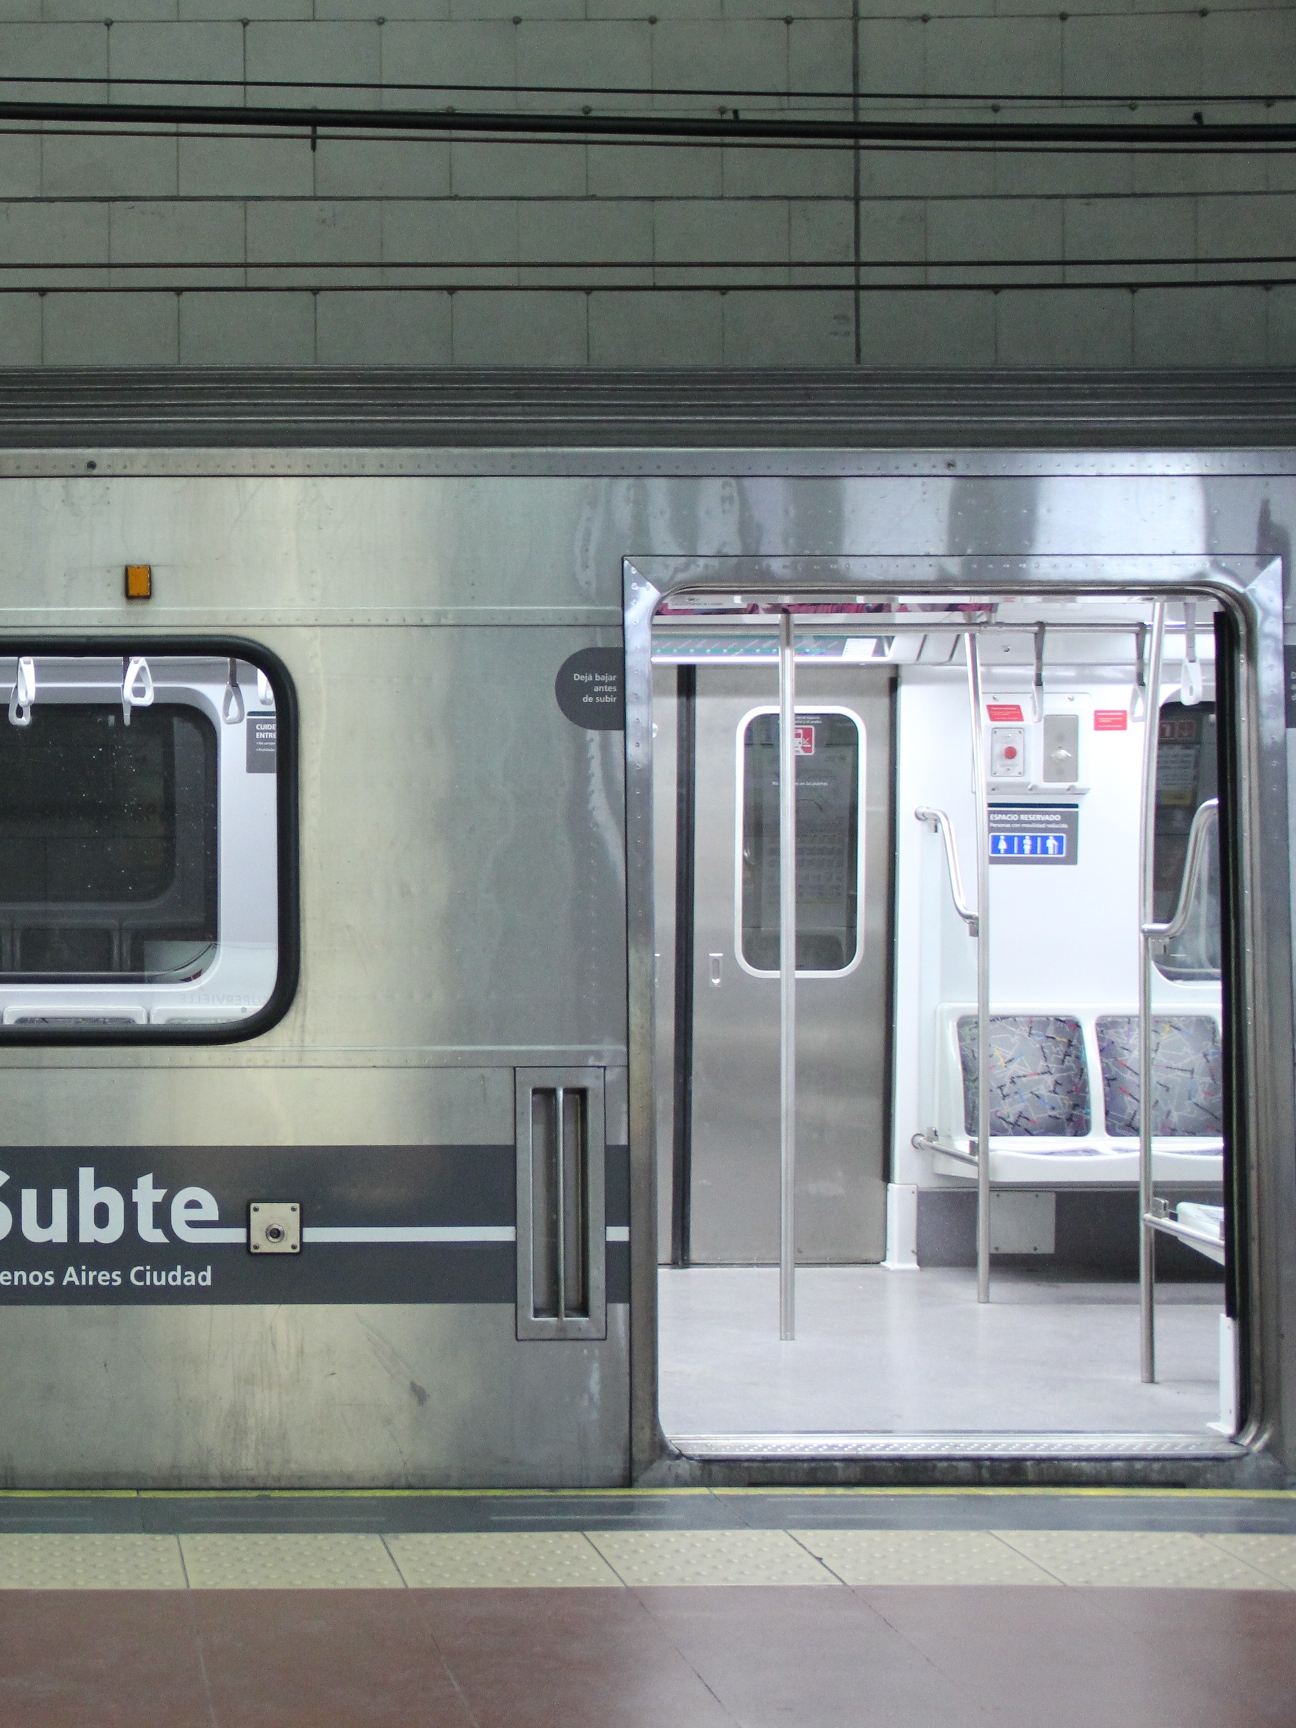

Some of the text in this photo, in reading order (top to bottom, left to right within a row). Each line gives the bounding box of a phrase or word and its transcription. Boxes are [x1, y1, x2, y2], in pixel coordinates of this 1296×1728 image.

[573, 673, 617, 683] Dejá bajar
[582, 694, 617, 703] de subir
[61, 1265, 122, 1287] Aires
[129, 1265, 212, 1287] Ciudad
